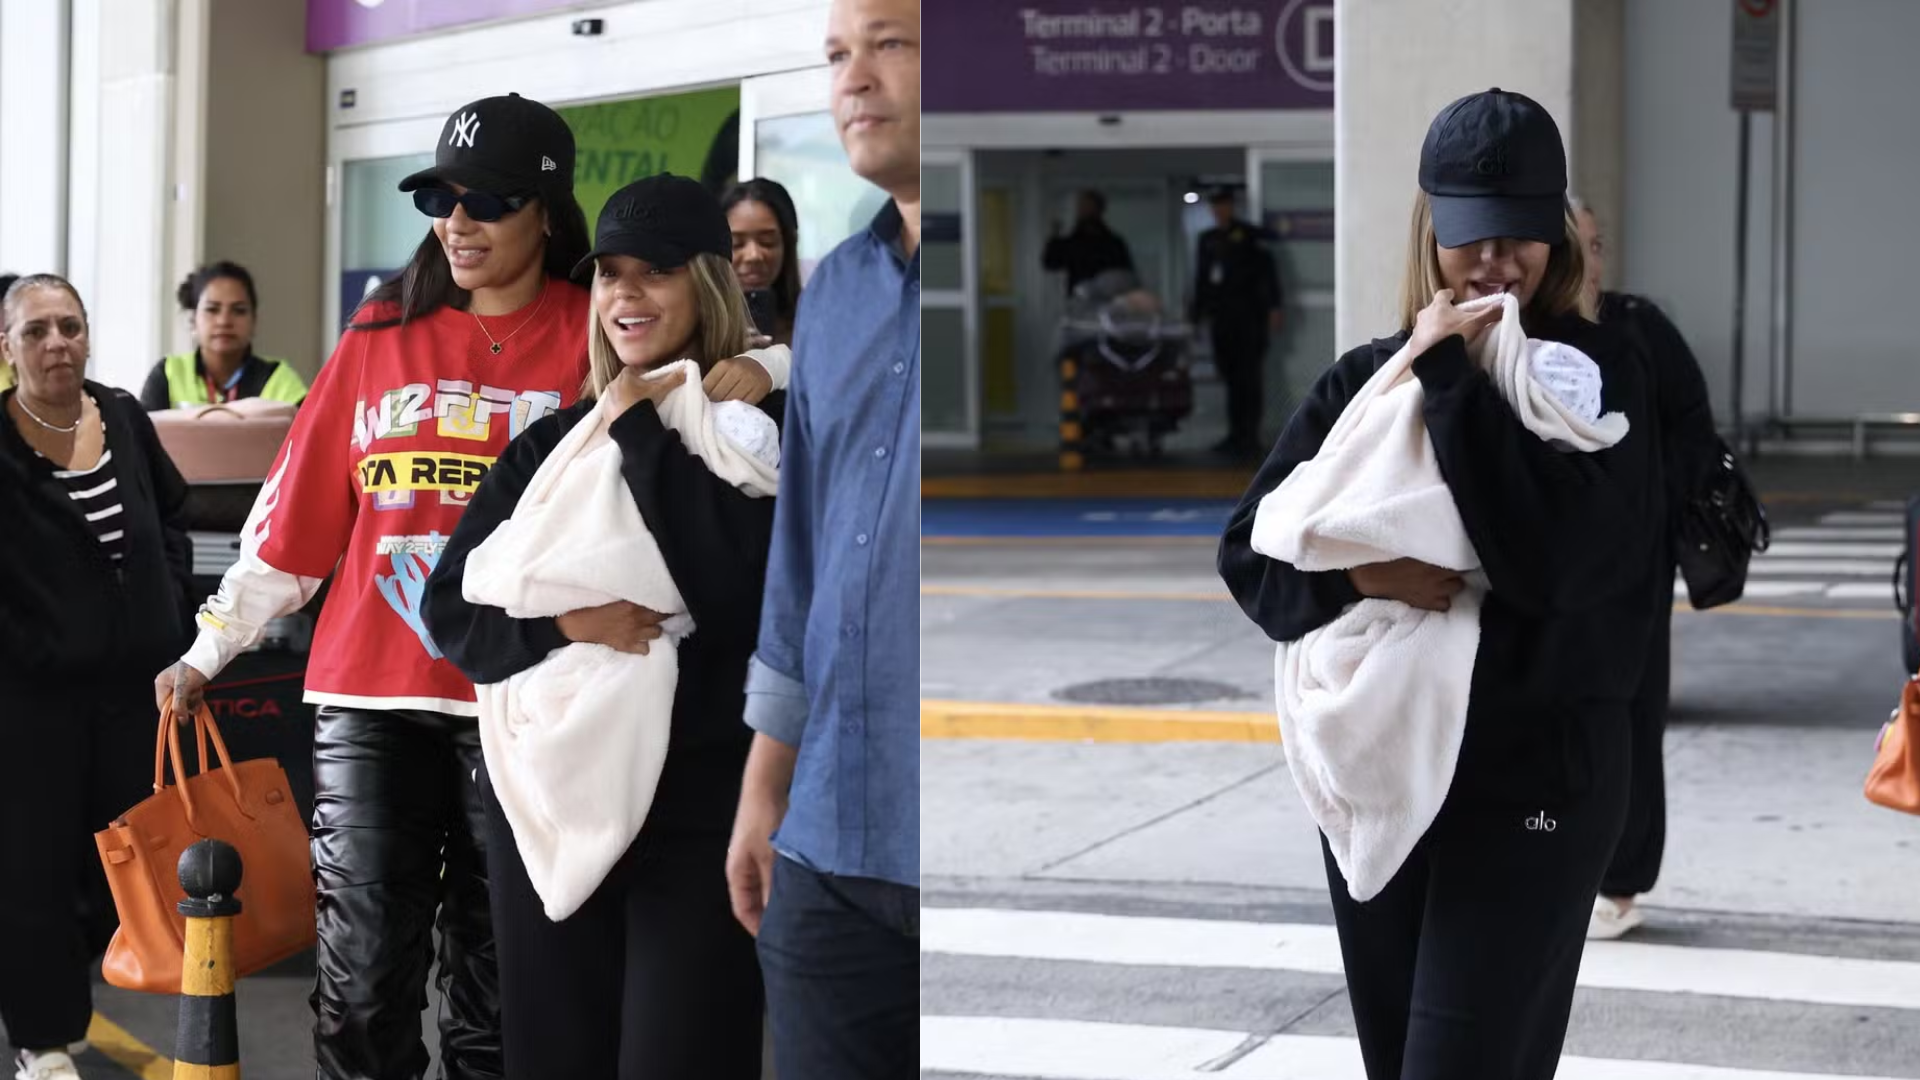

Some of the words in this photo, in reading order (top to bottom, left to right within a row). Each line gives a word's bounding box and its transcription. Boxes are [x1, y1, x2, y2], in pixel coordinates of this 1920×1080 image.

[1021, 9, 1140, 37] Terminal
[1145, 8, 1163, 37] 2
[1181, 8, 1261, 36] Porta
[1032, 45, 1146, 74] Terminal
[1152, 44, 1171, 73] 2
[1189, 44, 1260, 73] Door
[449, 111, 480, 148] NY
[411, 457, 497, 487] REP
[1525, 810, 1557, 832] alo
